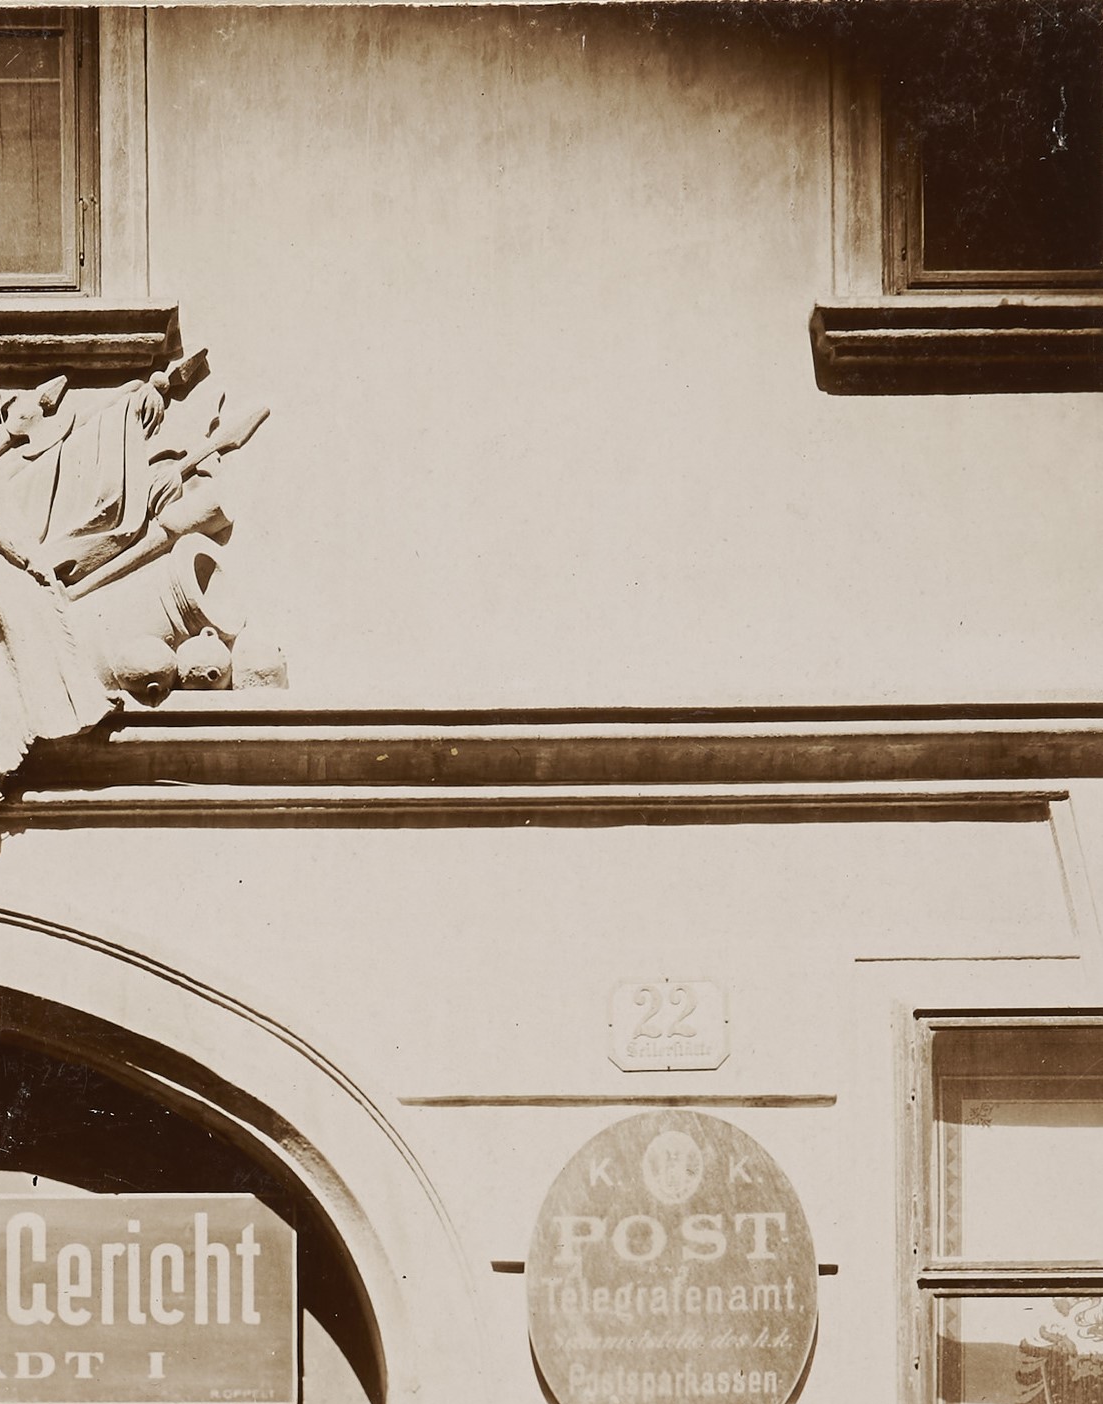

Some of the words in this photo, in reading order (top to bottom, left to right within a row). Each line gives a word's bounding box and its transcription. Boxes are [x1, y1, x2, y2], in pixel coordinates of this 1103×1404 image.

[632, 985, 698, 1040] 22
[589, 1157, 623, 1187] K.
[728, 1155, 763, 1184] K.
[147, 1351, 166, 1380] I
